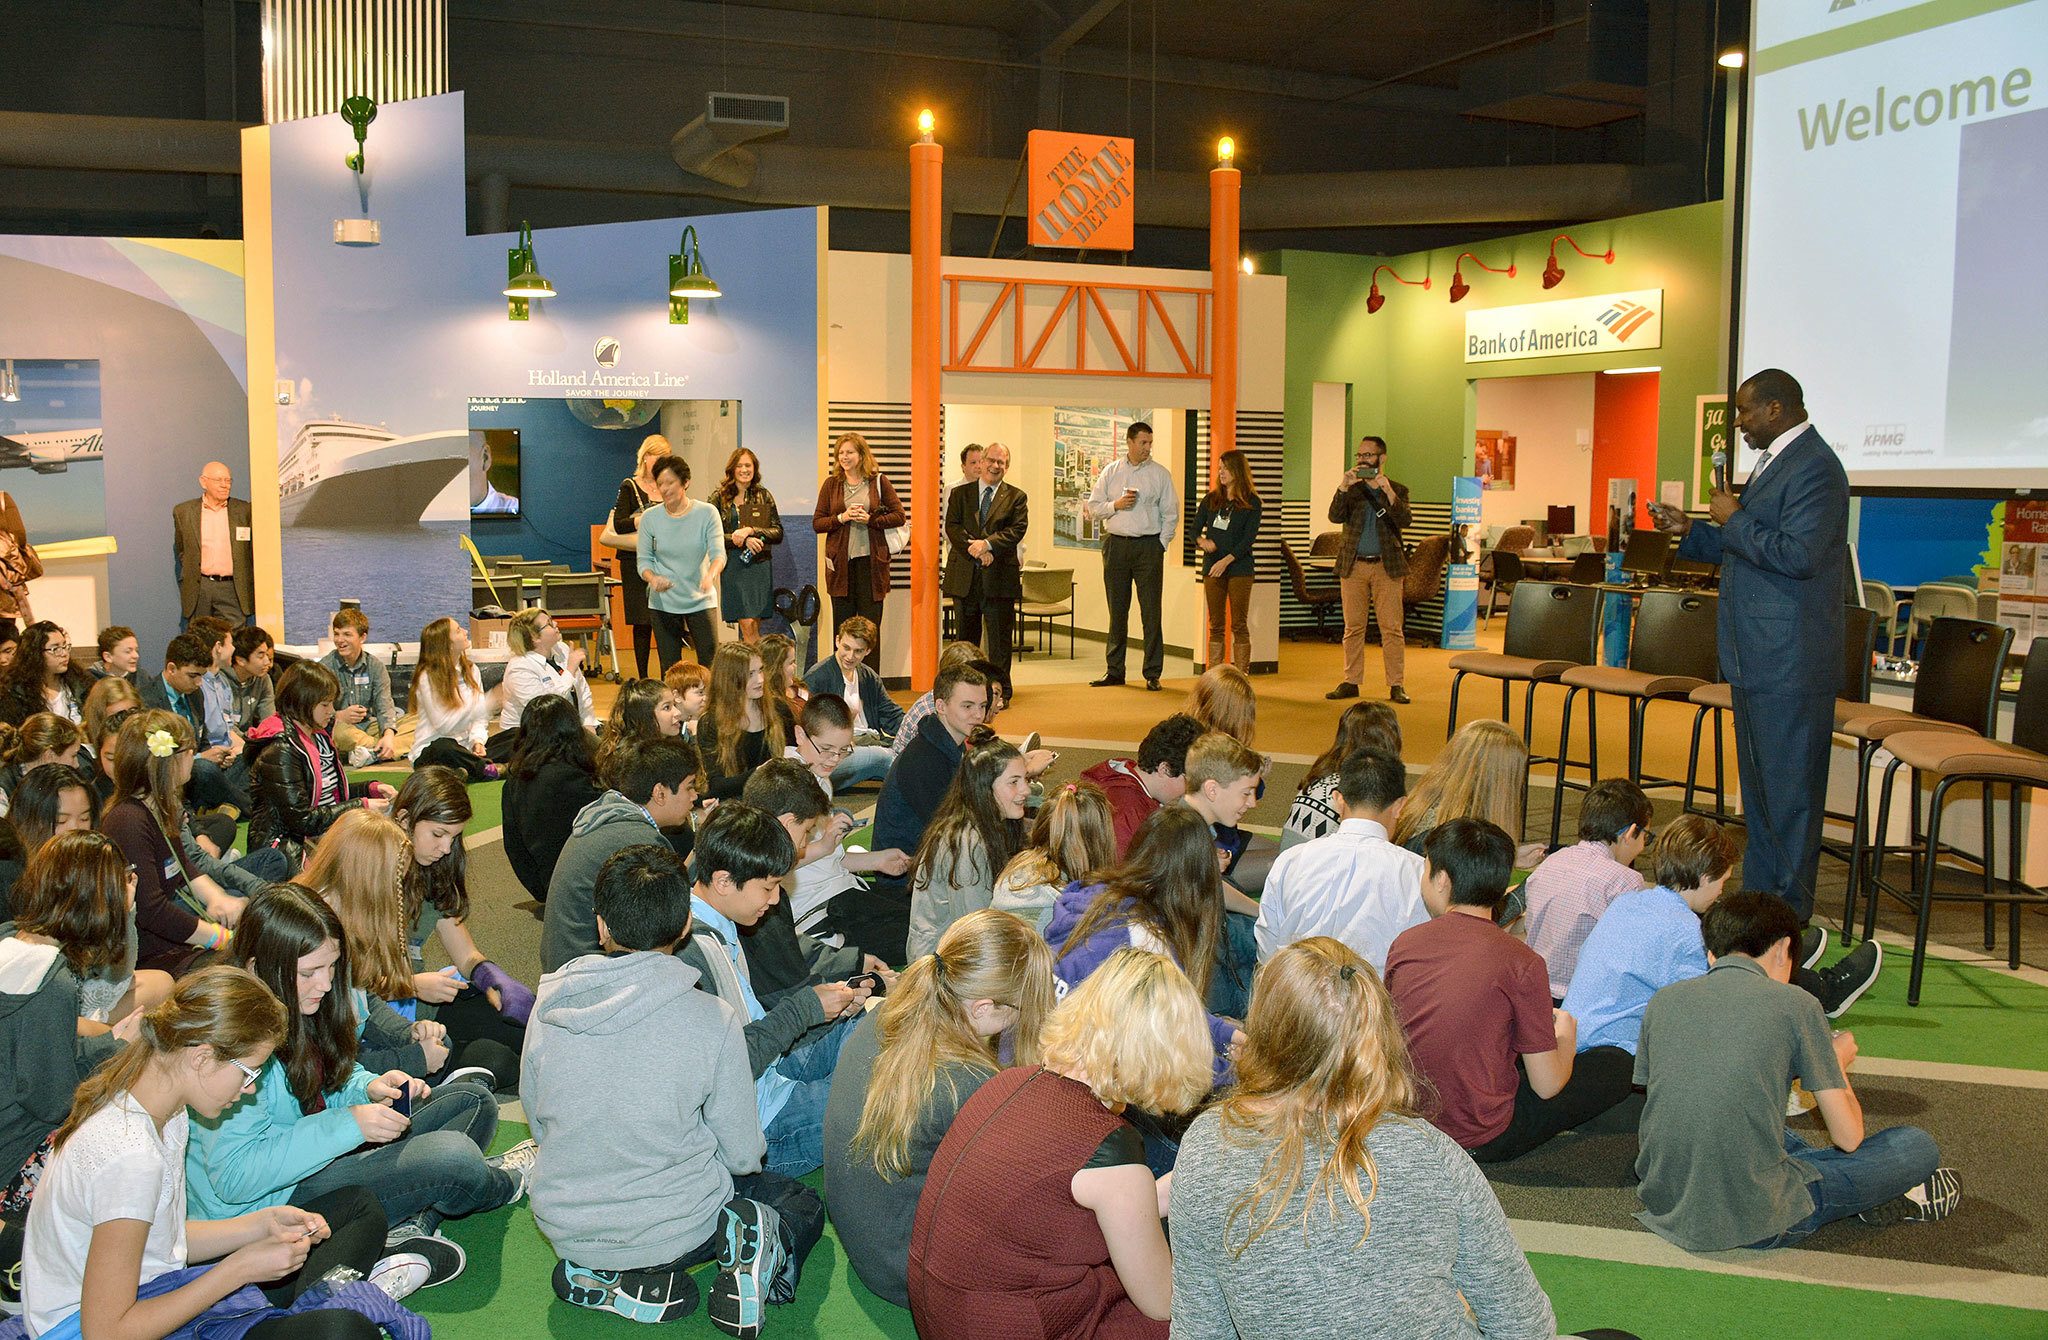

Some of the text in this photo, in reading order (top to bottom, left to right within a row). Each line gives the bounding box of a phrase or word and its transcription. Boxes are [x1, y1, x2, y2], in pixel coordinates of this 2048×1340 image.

[1797, 67, 2032, 151] Welcome
[1046, 146, 1088, 187] THE
[1036, 140, 1131, 242] HOME
[1072, 177, 1131, 243] DEPOT
[1469, 325, 1598, 356] Bank of America
[528, 369, 586, 387] Holland
[590, 370, 650, 387] America
[565, 389, 650, 398] SAVOR THE JOURNEY
[1704, 409, 1724, 431] JA
[1863, 433, 1904, 447] KPMG
